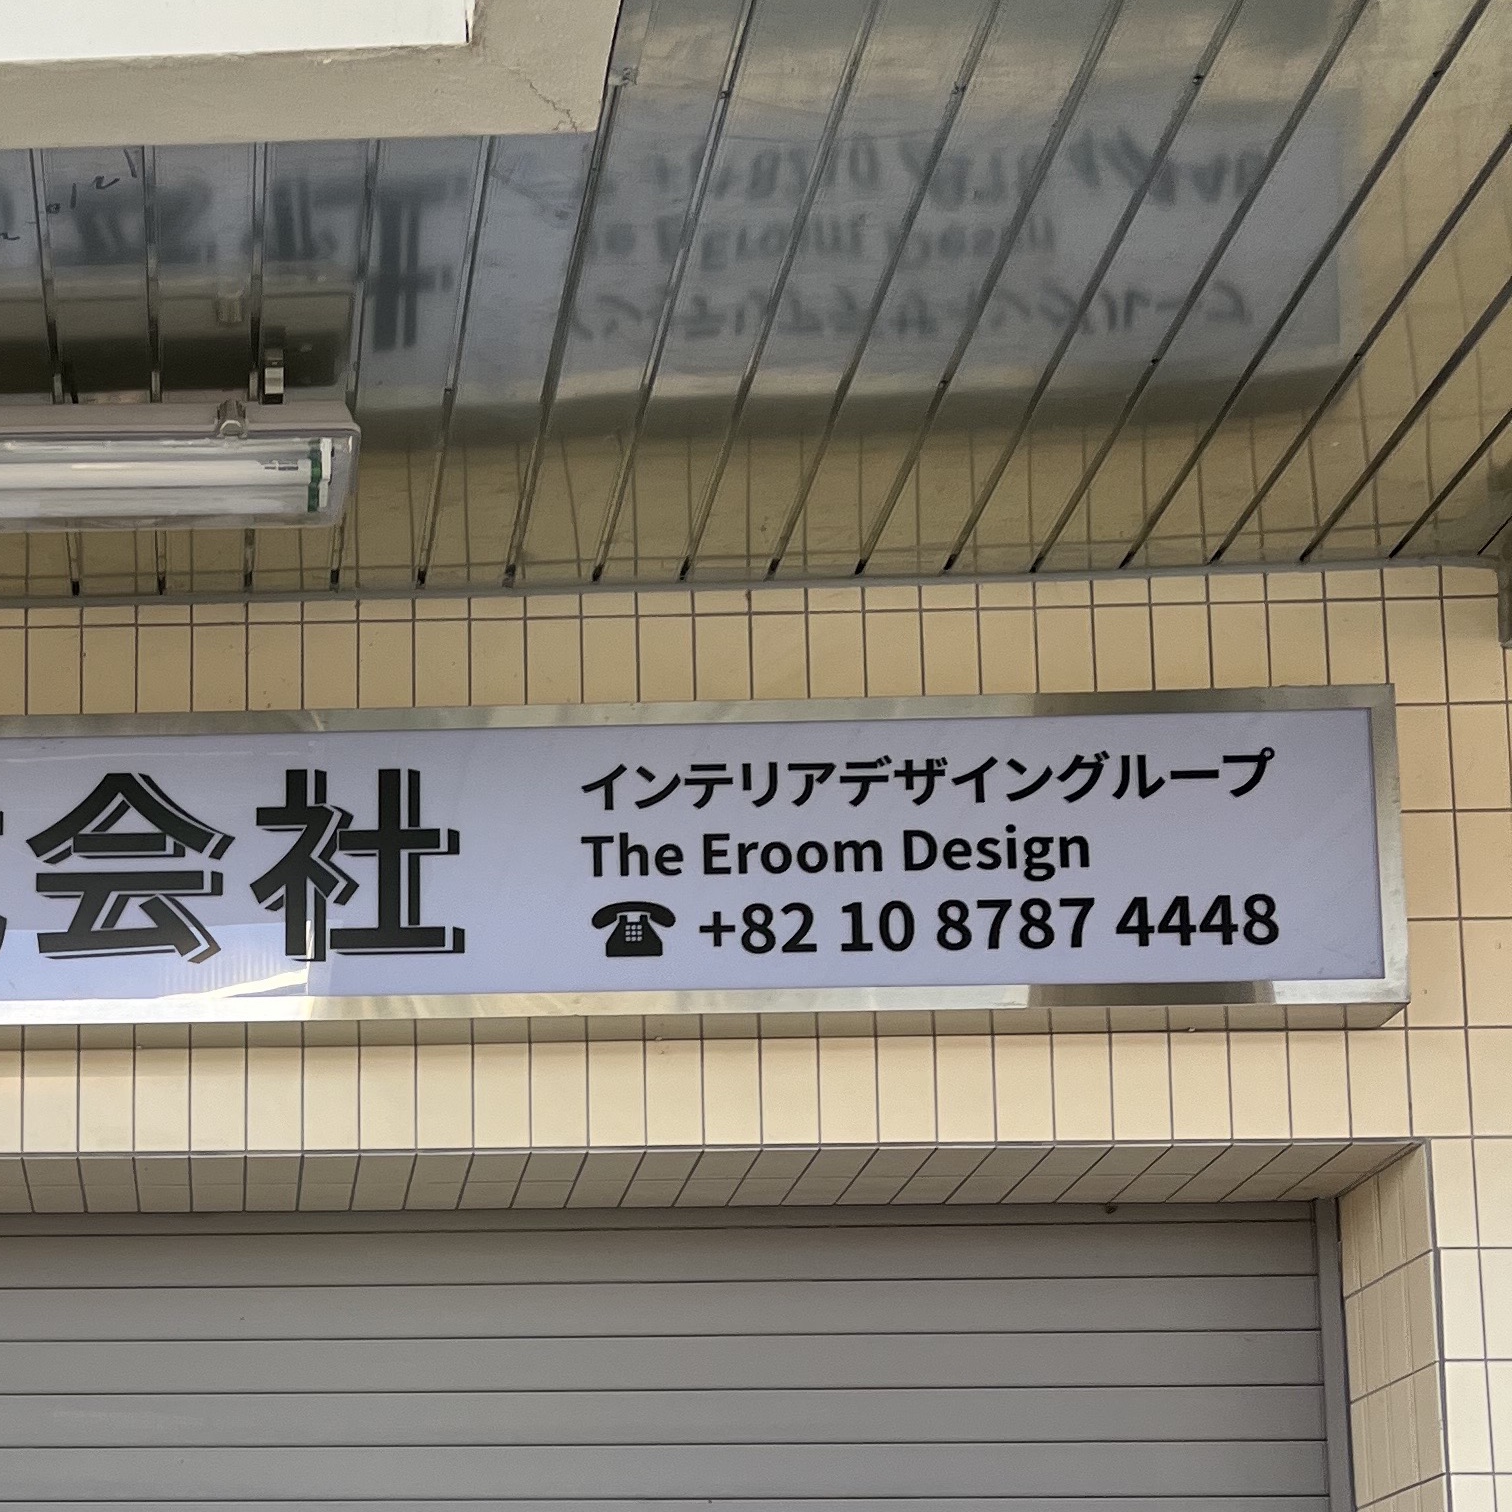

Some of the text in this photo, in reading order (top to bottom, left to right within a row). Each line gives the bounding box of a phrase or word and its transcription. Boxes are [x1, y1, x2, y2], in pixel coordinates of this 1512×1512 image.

[581, 746, 1275, 810] インテリアデザイングループ
[581, 824, 1090, 881] The Eroom Design
[699, 893, 1279, 954] +82 10 8787 4448
